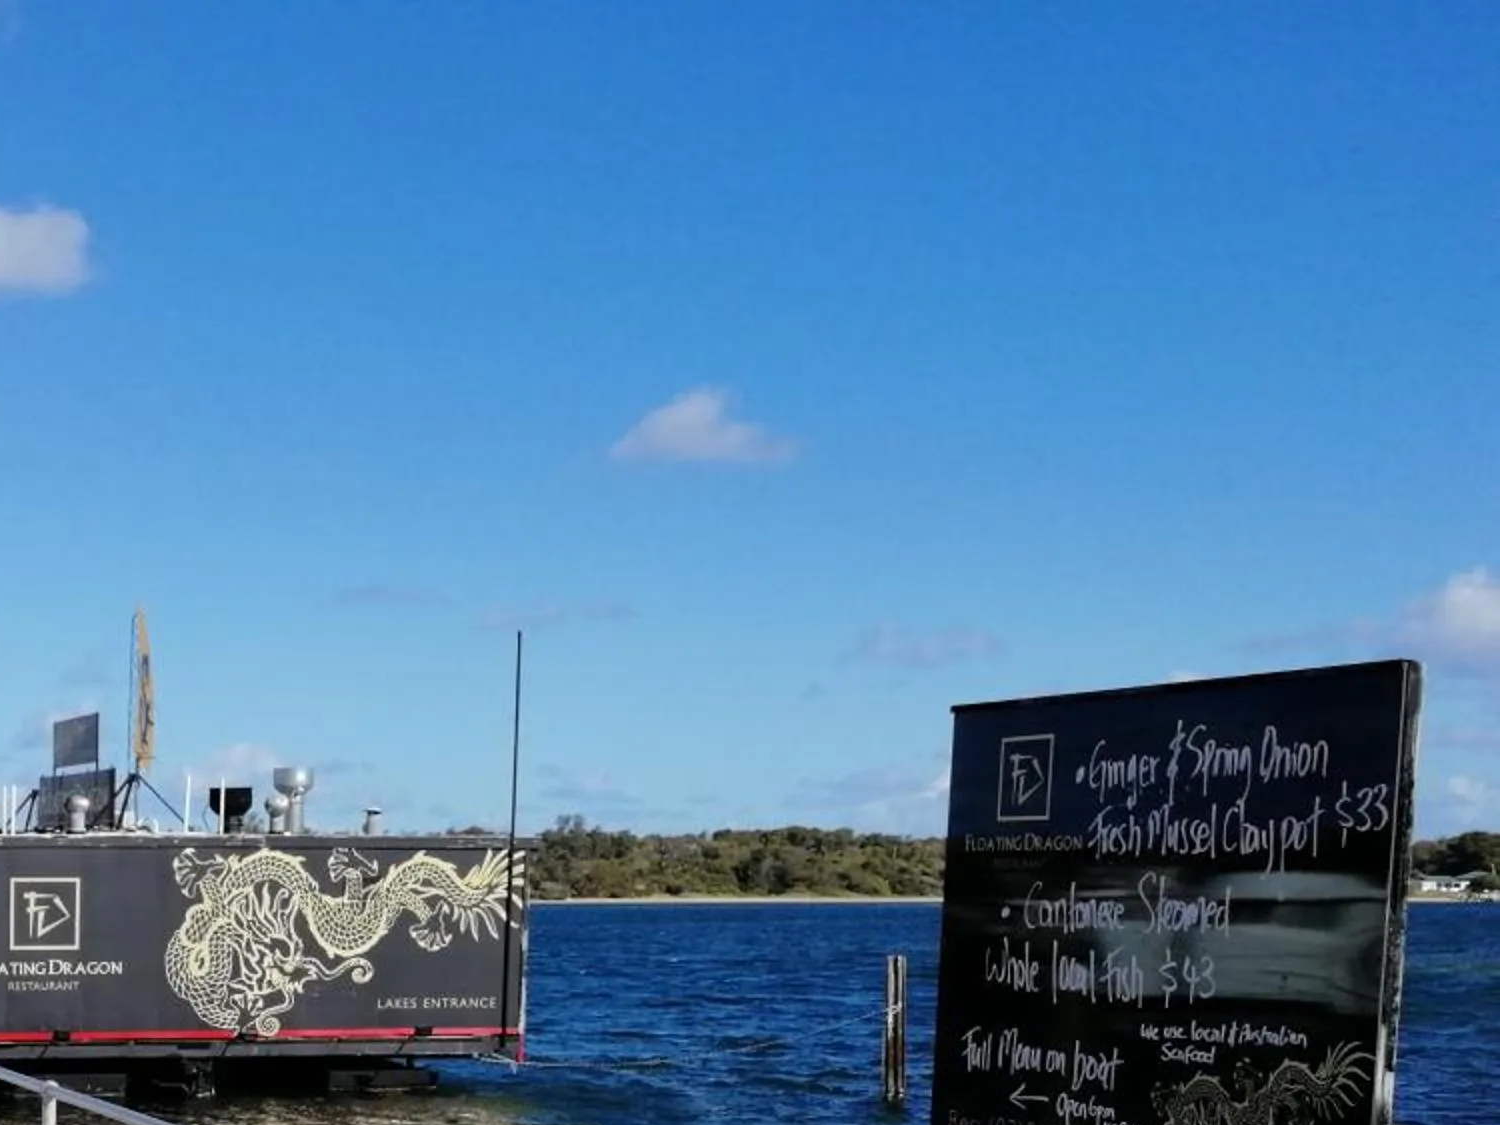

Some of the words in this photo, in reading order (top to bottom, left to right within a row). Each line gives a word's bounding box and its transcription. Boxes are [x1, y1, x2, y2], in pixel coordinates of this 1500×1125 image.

[1089, 739, 1161, 808] Ginger
[1259, 725, 1329, 784] Onion
[1088, 804, 1141, 860] Fresh
[1147, 803, 1217, 860] Mussel
[1334, 779, 1390, 849] $33
[377, 996, 417, 1009] LAKES
[423, 996, 498, 1009] ENTRANCE
[984, 936, 1040, 993] Whole
[1099, 945, 1145, 1009] Fish
[1158, 947, 1218, 1009] $43
[961, 1026, 993, 1072] Full
[997, 1027, 1041, 1075] Menu
[1045, 1050, 1066, 1077] on
[1071, 1039, 1125, 1091] boat
